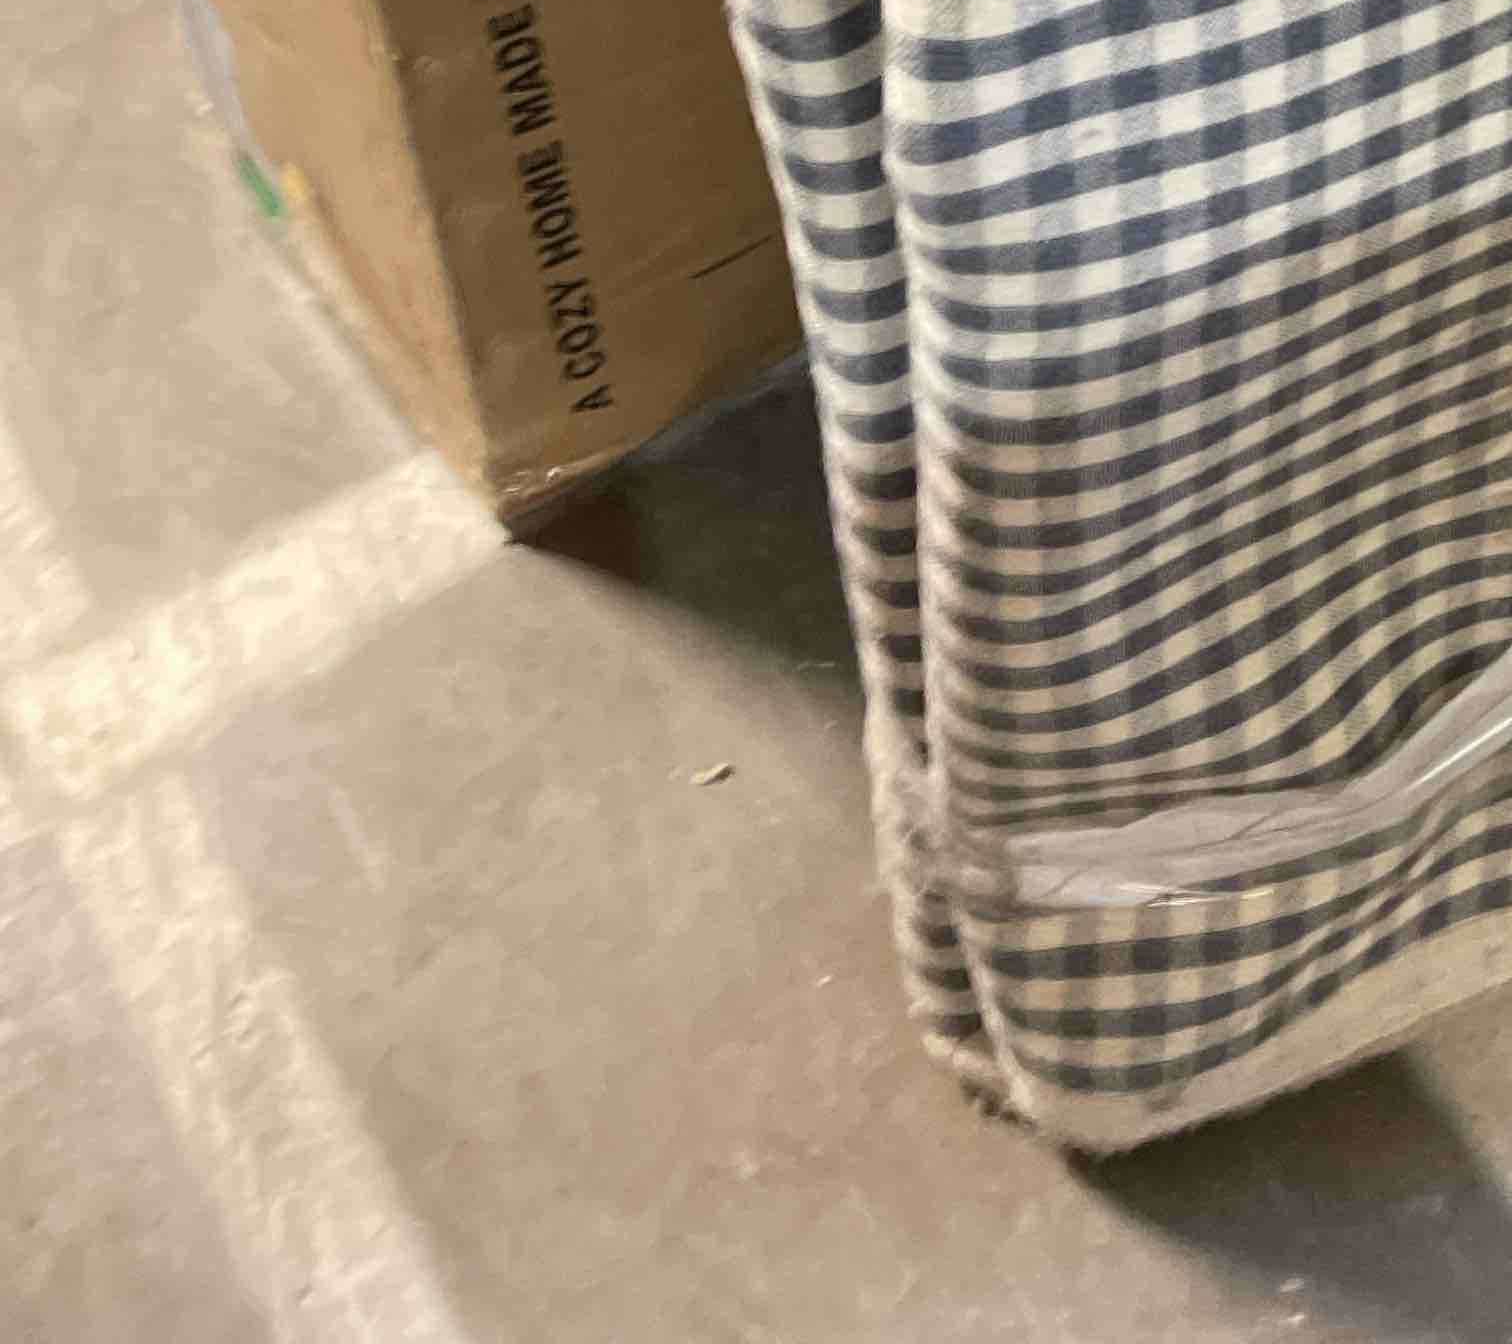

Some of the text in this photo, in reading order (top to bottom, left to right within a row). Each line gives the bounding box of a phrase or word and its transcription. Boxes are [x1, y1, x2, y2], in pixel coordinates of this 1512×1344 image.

[486, 3, 556, 137] MADE
[517, 140, 584, 270] HOME
[545, 276, 610, 382] COZY
[571, 383, 616, 413] A
